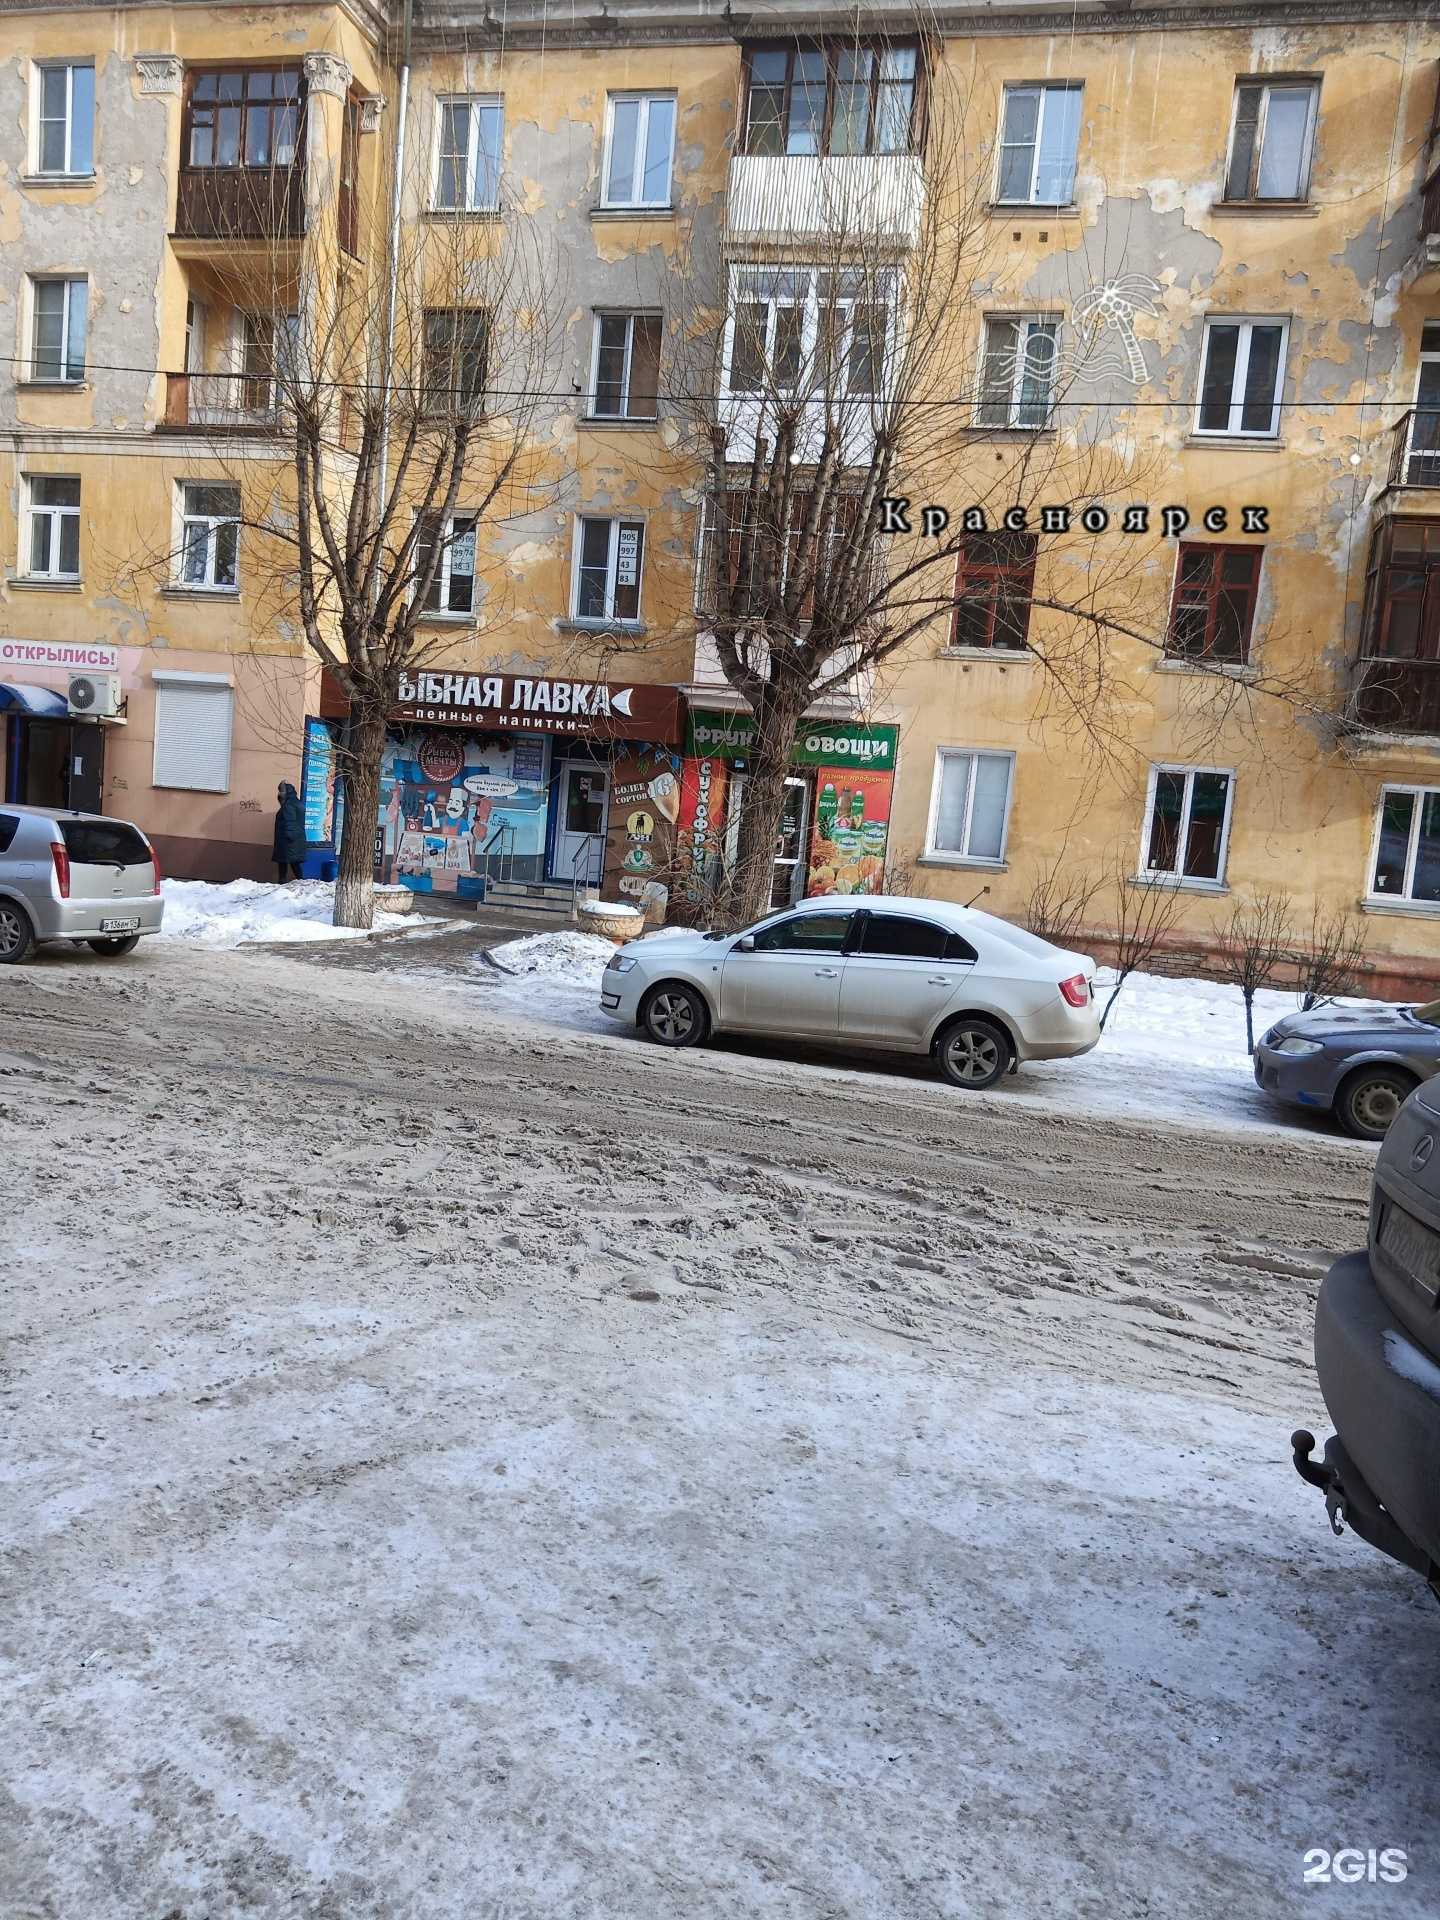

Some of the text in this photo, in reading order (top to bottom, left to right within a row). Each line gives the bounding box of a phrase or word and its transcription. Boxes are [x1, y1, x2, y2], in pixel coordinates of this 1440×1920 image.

[621, 533, 636, 542] 905
[620, 547, 636, 556] 997
[620, 561, 630, 569] 43
[619, 575, 629, 583] 83
[2, 644, 115, 665] ОТКРЫЛИСЬ!
[399, 671, 612, 717] ЫБНАЯ ЛАВКА
[416, 709, 577, 731] пенные напитки
[694, 725, 889, 762] ФРУК ОВОЩИ
[427, 746, 456, 758] РЫБКА
[427, 756, 457, 766] МЕЧТЫ
[614, 782, 646, 795] БОЛЕЕ
[615, 792, 648, 804] СОРТОВ
